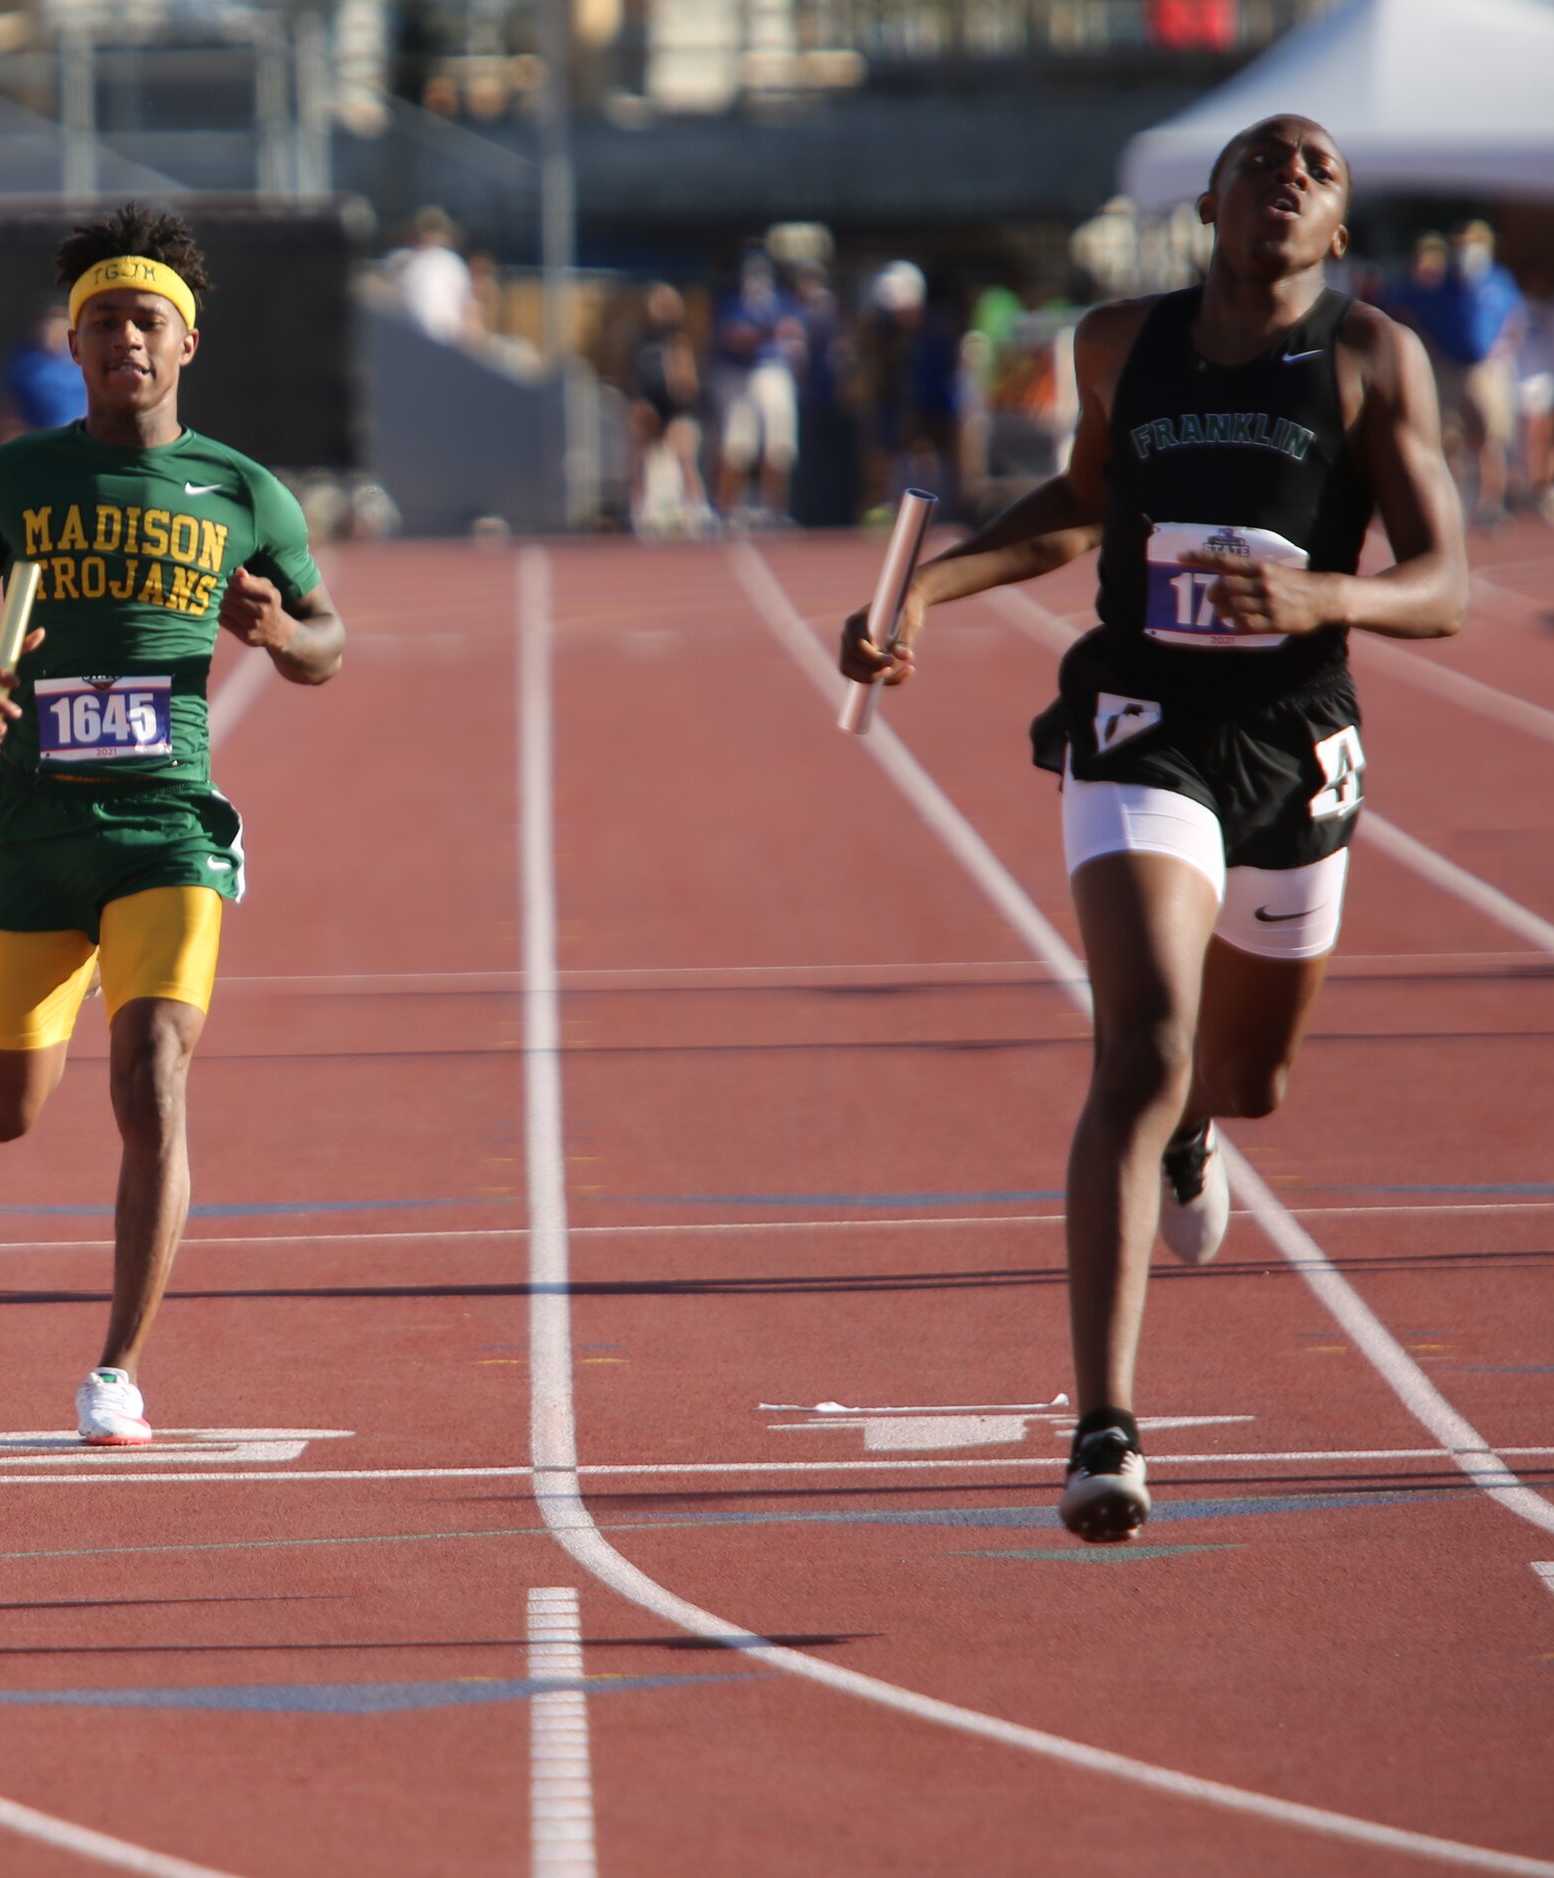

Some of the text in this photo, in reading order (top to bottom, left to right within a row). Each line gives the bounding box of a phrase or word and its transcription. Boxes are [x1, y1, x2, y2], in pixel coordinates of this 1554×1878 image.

[1130, 412, 1317, 462] FRANKLIN
[22, 504, 229, 573] MADISON
[50, 692, 158, 745] 1645
[96, 748, 118, 757] 2021
